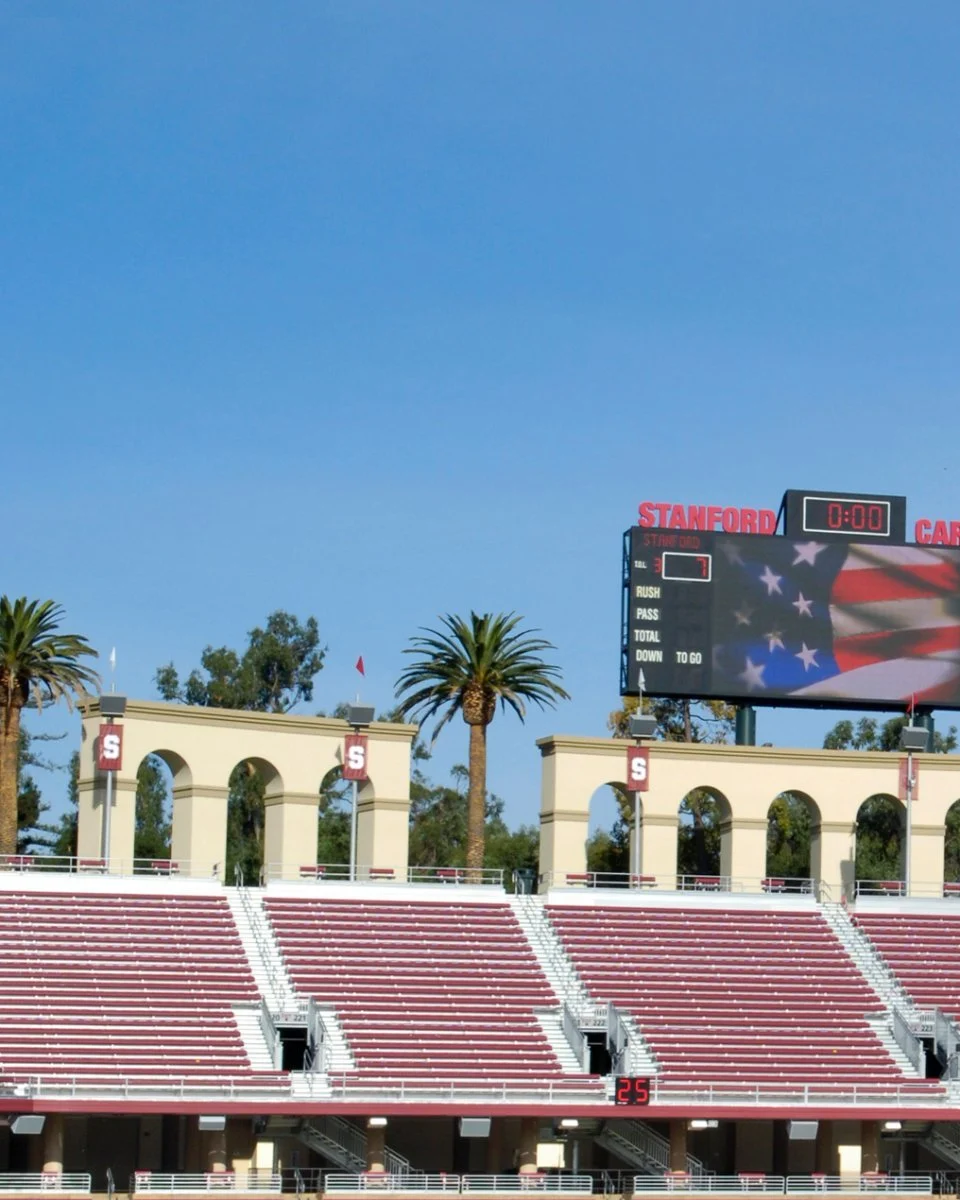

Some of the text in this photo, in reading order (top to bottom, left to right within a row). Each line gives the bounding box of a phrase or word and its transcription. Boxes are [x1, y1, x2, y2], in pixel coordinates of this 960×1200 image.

[638, 501, 777, 536] STANFORD
[827, 502, 883, 531] 0:00
[696, 556, 708, 577] 7
[635, 585, 661, 599] RUSH
[636, 607, 659, 621] PASS
[633, 629, 661, 643] TOTAL
[635, 649, 663, 663] DOWN
[676, 651, 702, 665] TO GO
[103, 734, 120, 760] S
[348, 745, 365, 770] S
[631, 756, 647, 781] S
[618, 1079, 649, 1102] 25
